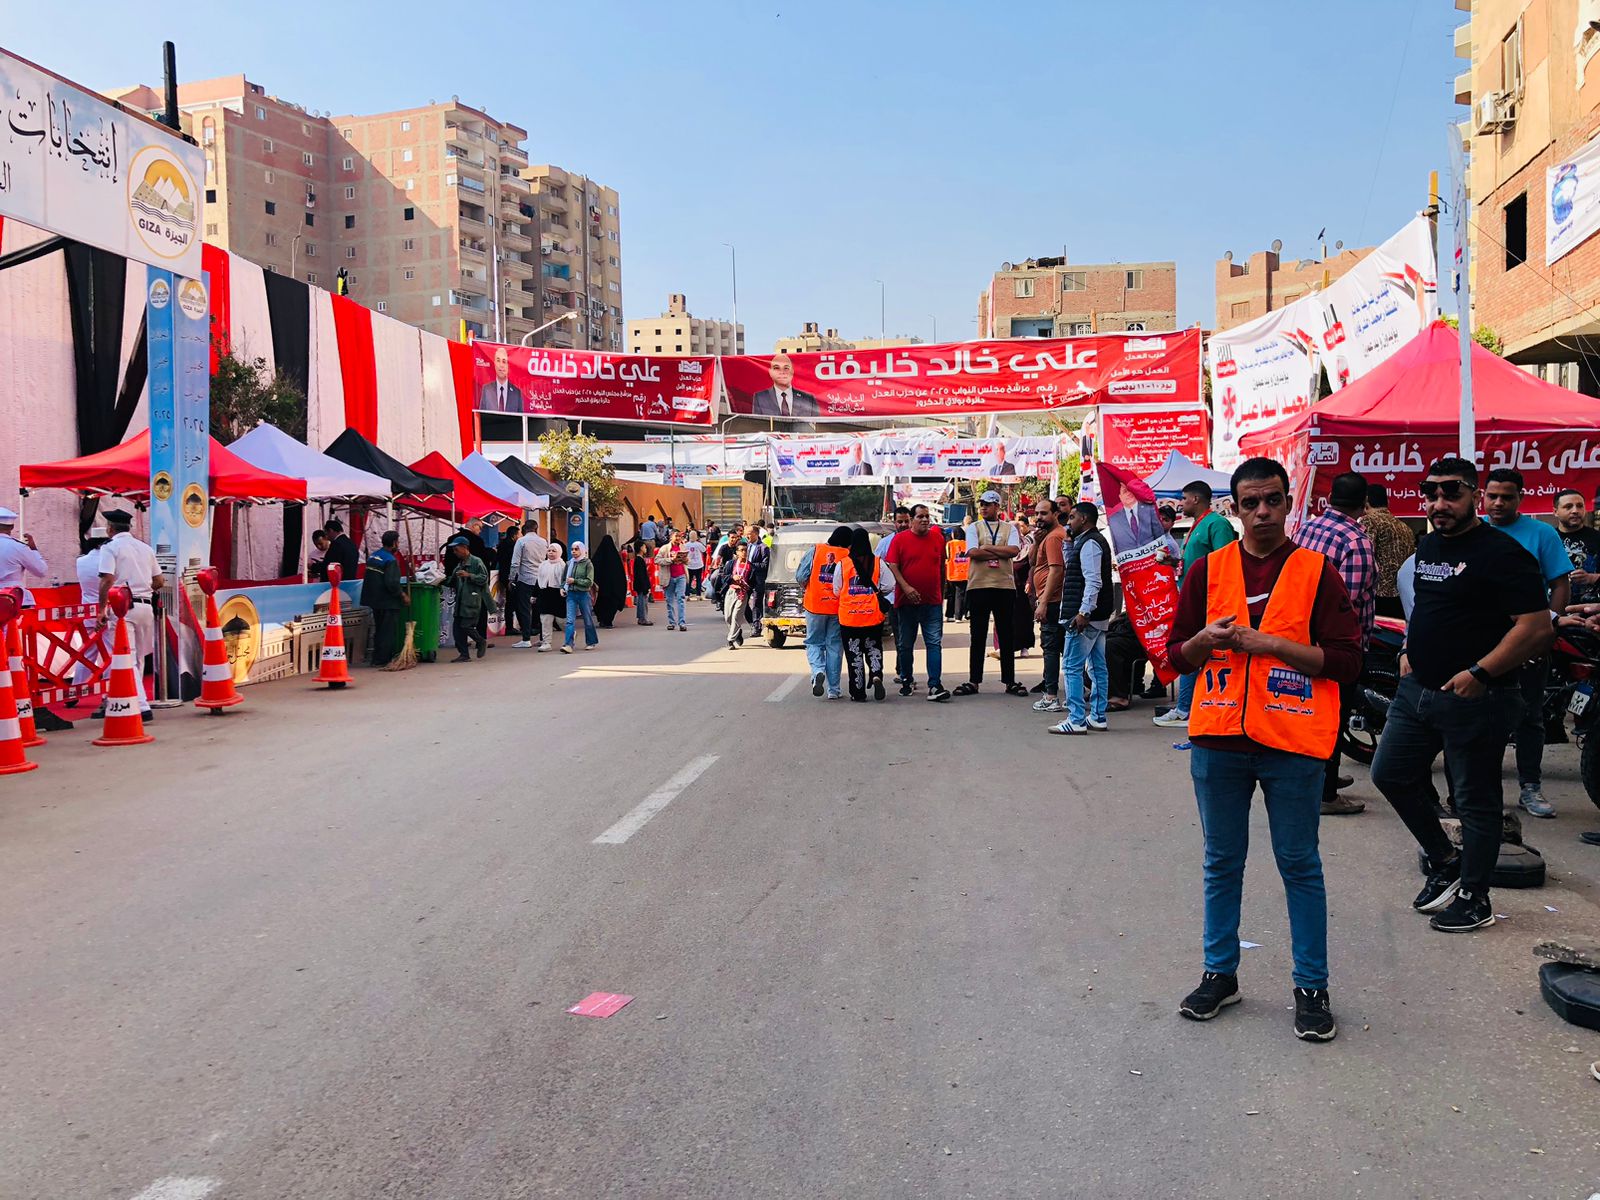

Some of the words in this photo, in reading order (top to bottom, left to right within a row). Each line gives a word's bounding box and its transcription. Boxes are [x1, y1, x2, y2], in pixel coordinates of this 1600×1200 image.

[138, 218, 161, 236] GIZA
[165, 228, 188, 245] الجيزة
[1009, 344, 1097, 379] علي
[1125, 352, 1147, 361] العدل
[1148, 352, 1166, 360] حزب
[528, 351, 577, 384] خليفة
[815, 351, 918, 385] خليفة
[926, 349, 999, 376] خالد
[581, 357, 616, 381] خالد
[620, 357, 660, 387] علي
[1145, 367, 1169, 375] العدل
[930, 387, 949, 395] ٢٠٢٥
[952, 386, 976, 395] النواب
[978, 386, 1005, 394] مجلس
[1007, 382, 1030, 393] مرشح
[1036, 384, 1057, 393] رقم
[1112, 383, 1136, 393] نوفمبر
[633, 393, 646, 403] رقم
[871, 390, 895, 399] العدل
[896, 390, 914, 398] حزب
[915, 398, 944, 407] الدكرور
[945, 397, 965, 406] بولاق
[966, 397, 985, 405] دائرة
[1042, 395, 1054, 405] ١٤
[635, 403, 644, 416] ١٤
[183, 417, 205, 433] ٢٠٢٥
[1112, 455, 1146, 467] خليفة
[1310, 452, 1337, 464] الحصان
[1489, 440, 1543, 471] خالد
[1350, 442, 1425, 481] خليفة
[1393, 488, 1416, 499] حزب
[1135, 547, 1151, 558] خالد
[1205, 668, 1232, 695] ١٢
[110, 702, 130, 712] مرور
